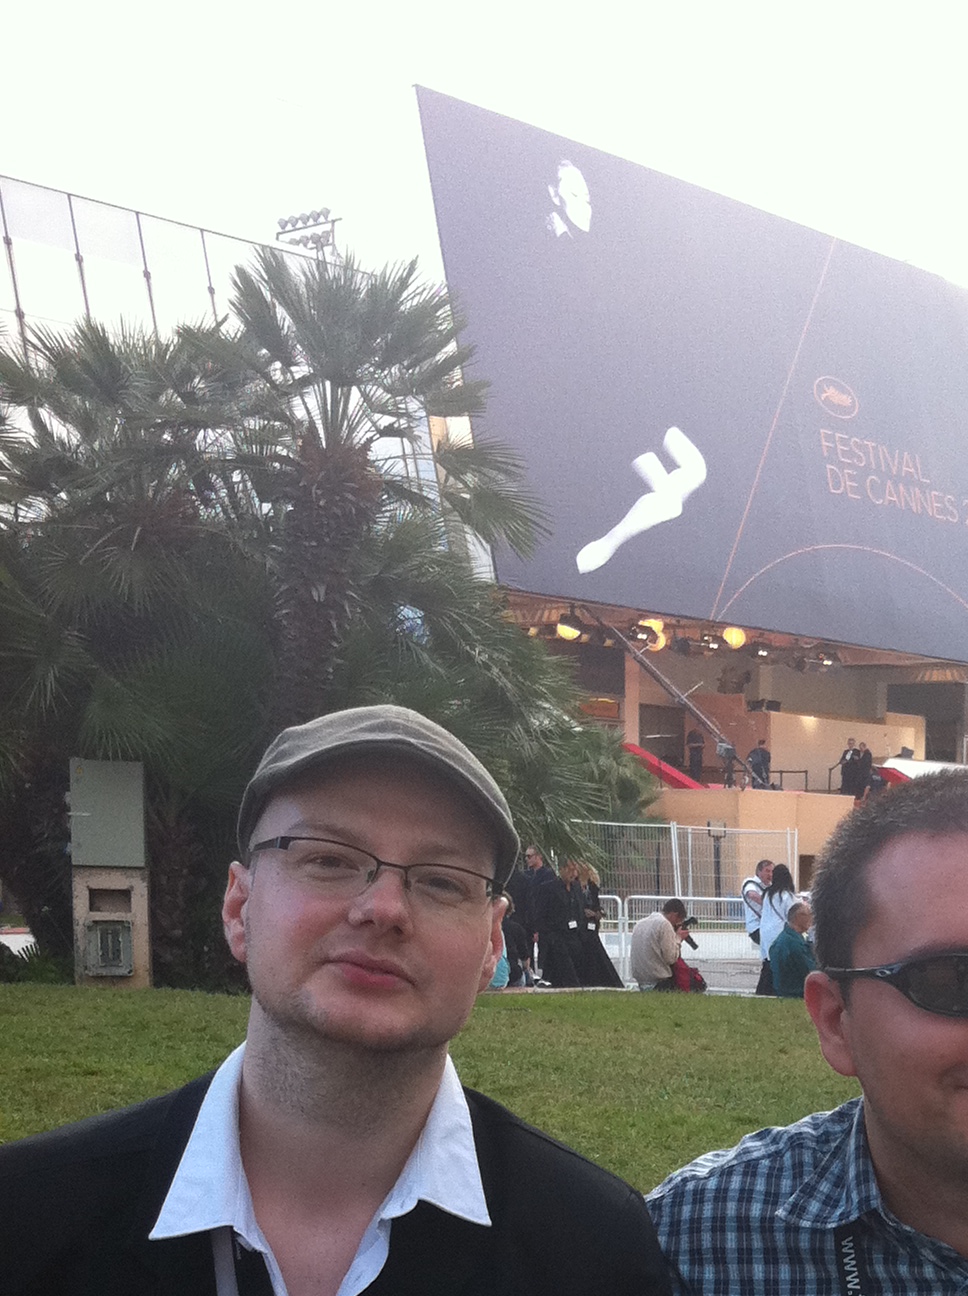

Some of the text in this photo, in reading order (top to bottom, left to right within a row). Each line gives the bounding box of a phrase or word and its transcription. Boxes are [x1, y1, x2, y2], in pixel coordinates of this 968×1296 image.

[820, 428, 931, 484] FESTIVAL
[826, 464, 861, 500] DE
[866, 475, 959, 523] CANNES
